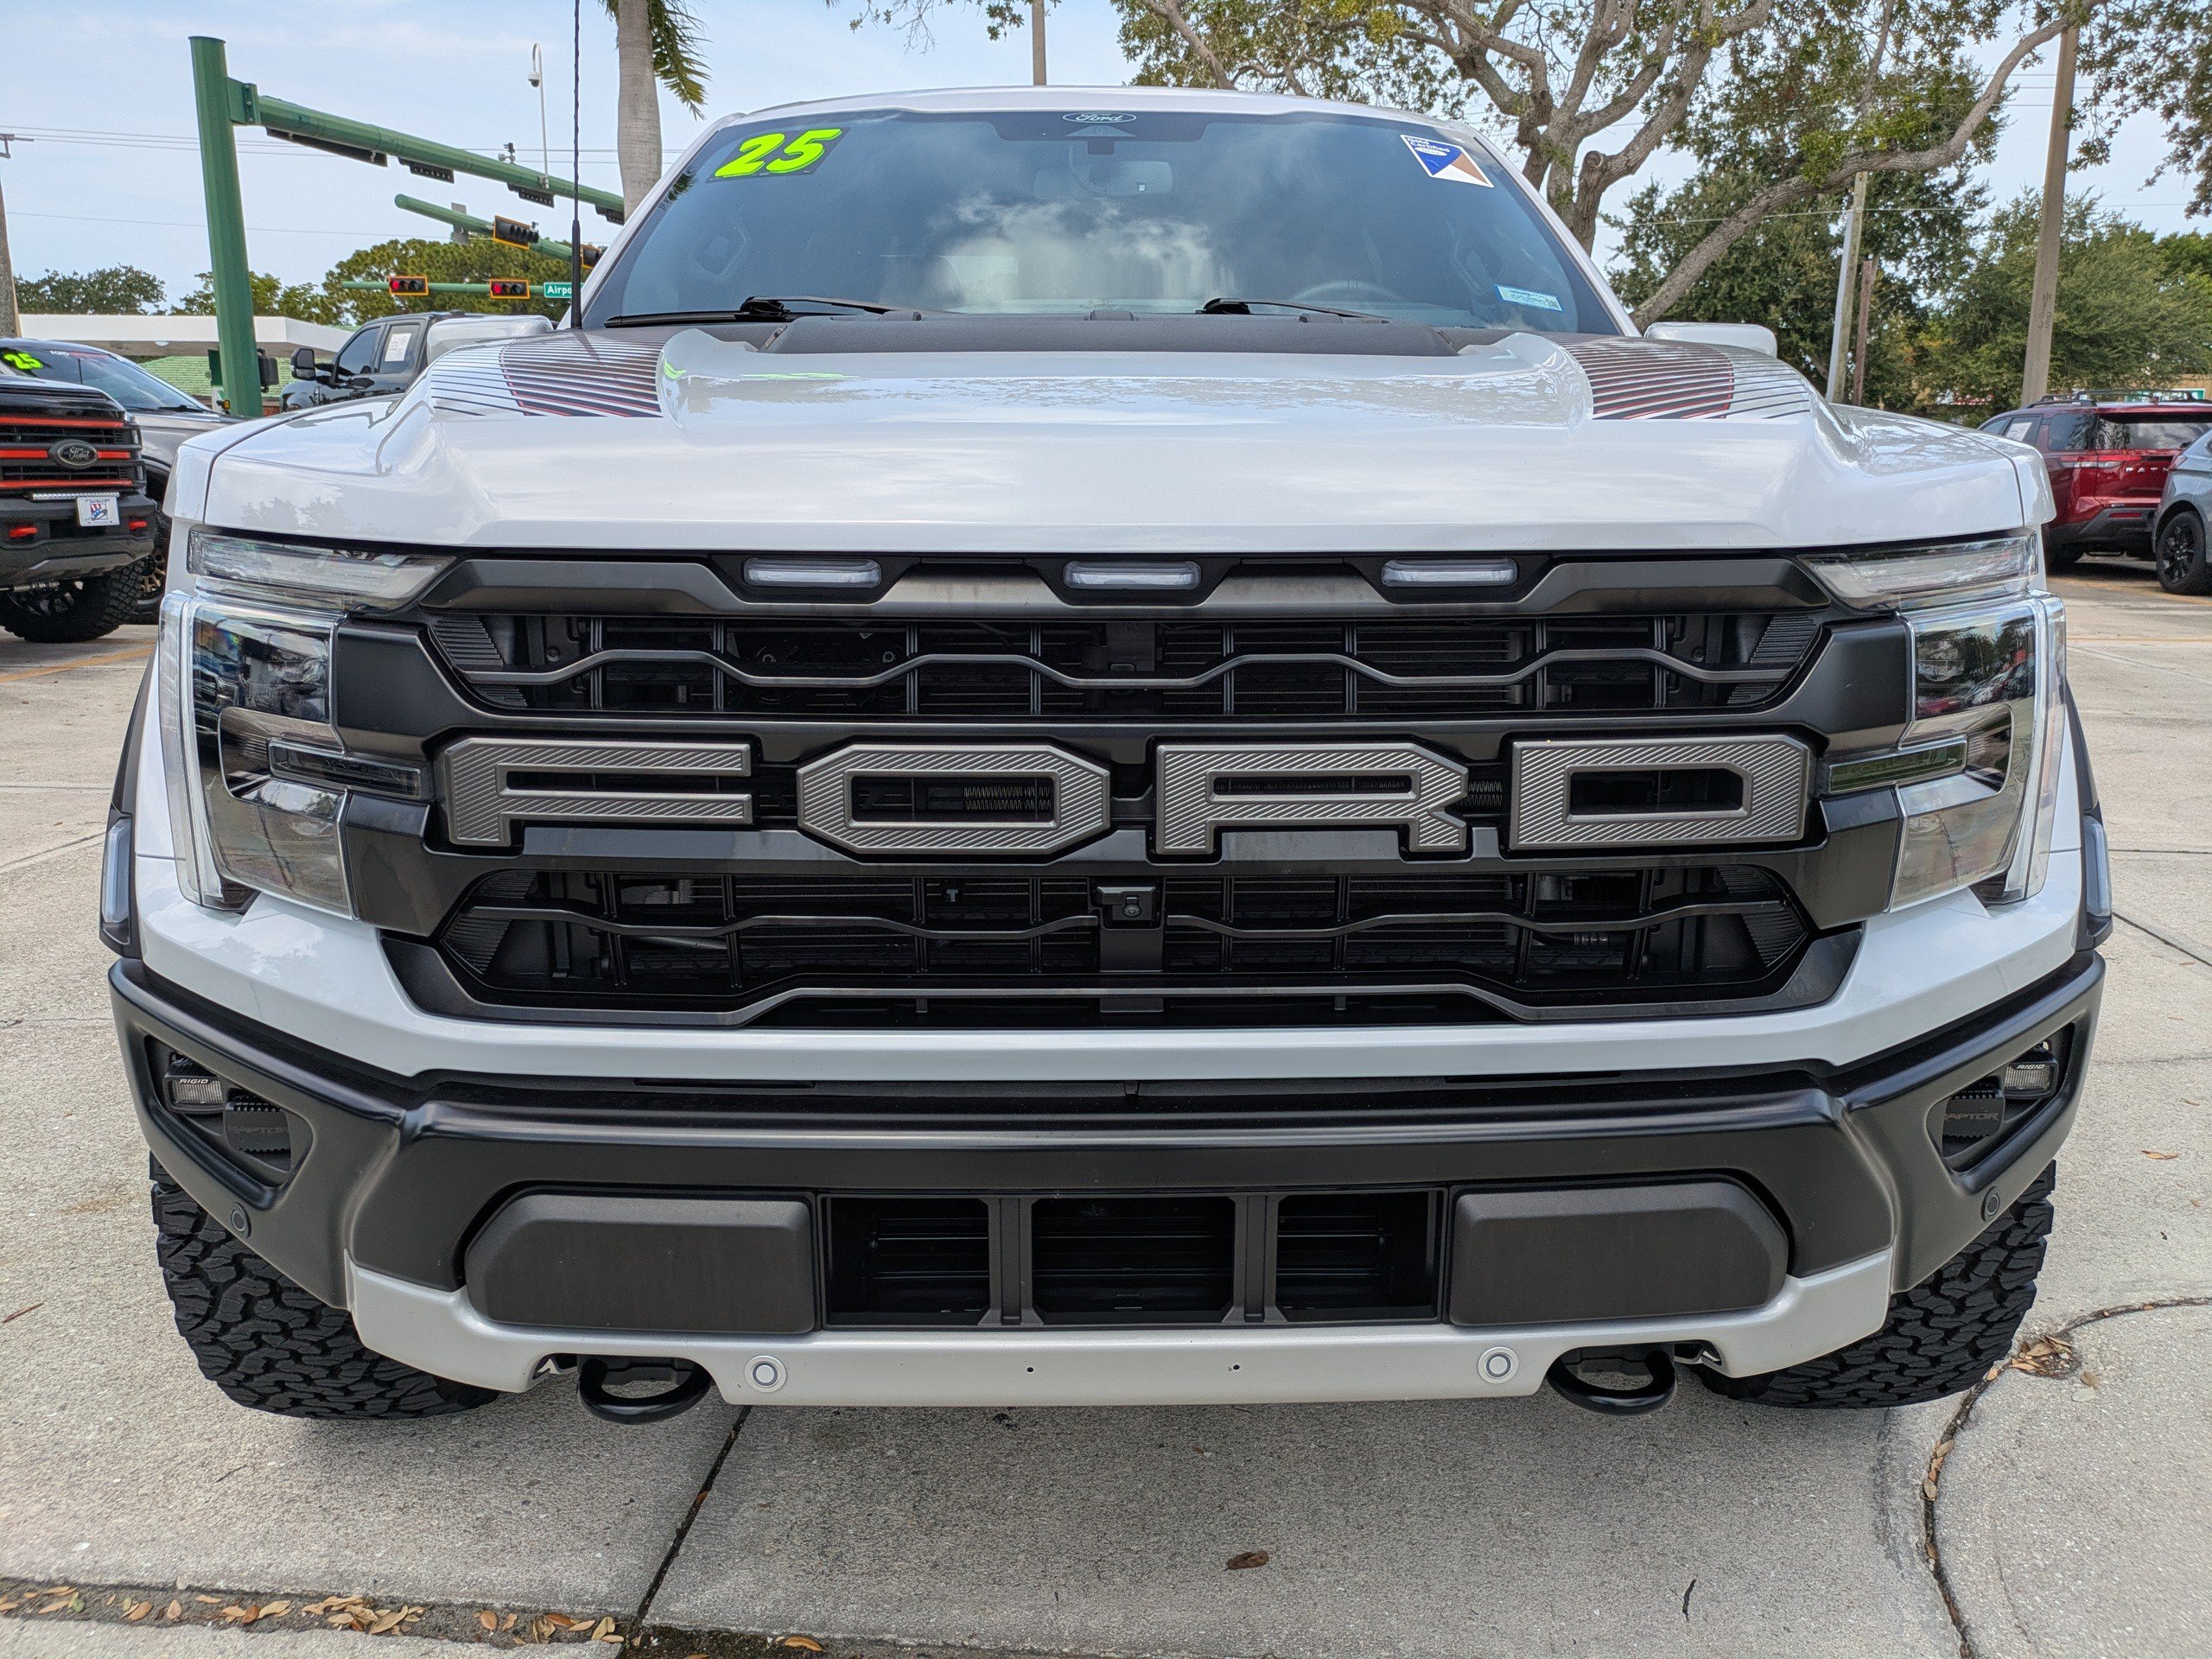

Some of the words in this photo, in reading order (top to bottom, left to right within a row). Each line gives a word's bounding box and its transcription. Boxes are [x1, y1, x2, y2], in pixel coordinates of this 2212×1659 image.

[1075, 112, 1124, 122] Ford
[715, 128, 842, 178] 25
[547, 285, 572, 296] Airpo
[3, 353, 43, 369] 25
[443, 733, 1812, 857] FORD
